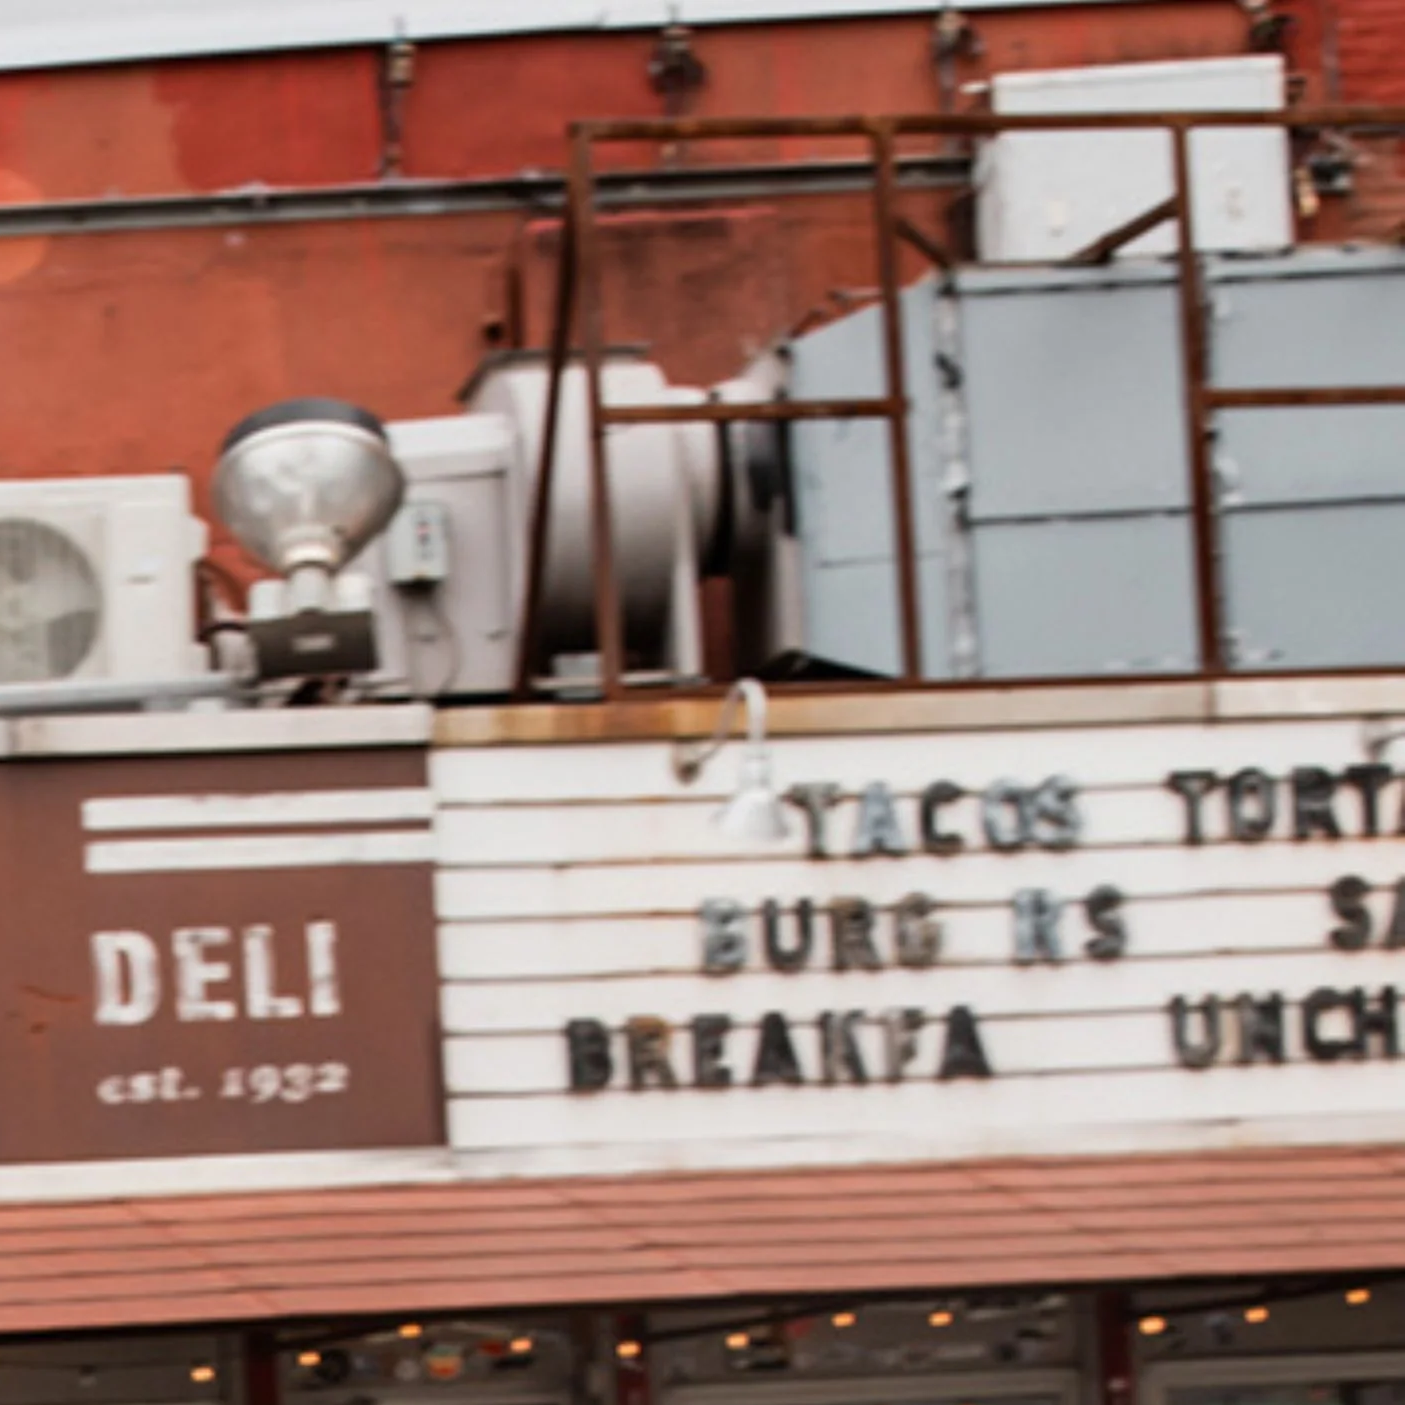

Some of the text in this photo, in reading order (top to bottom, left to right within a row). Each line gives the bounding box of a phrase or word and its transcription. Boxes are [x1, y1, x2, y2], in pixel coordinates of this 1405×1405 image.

[784, 763, 1405, 861] TACOS TORT
[89, 920, 342, 1027] DELI
[218, 1061, 350, 1104] 1932
[564, 985, 1399, 1096] BREAKFA UNCH
